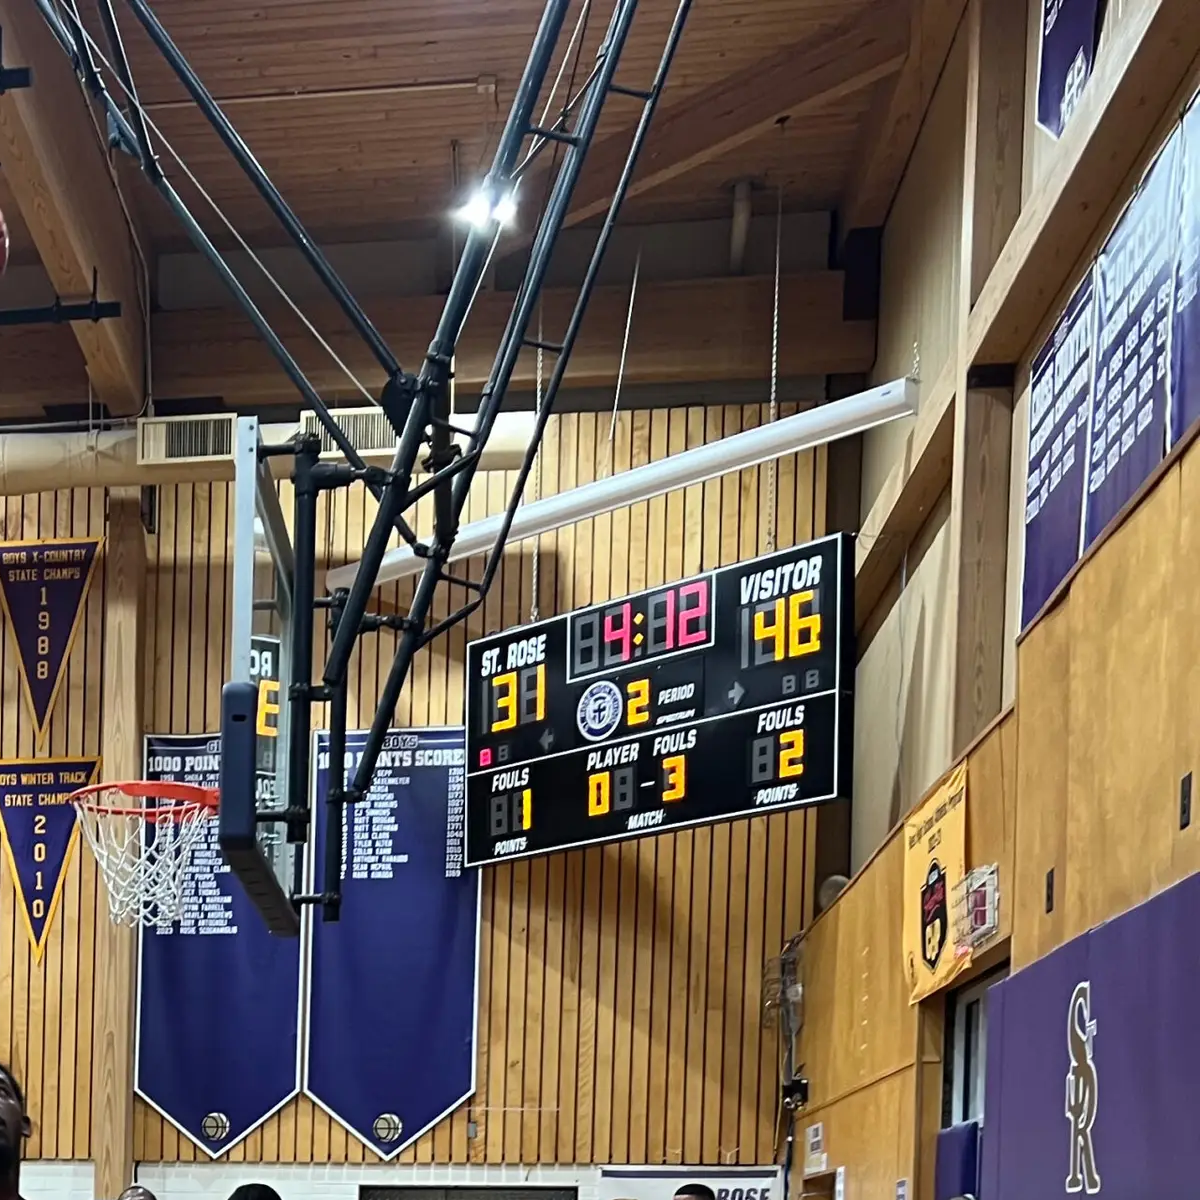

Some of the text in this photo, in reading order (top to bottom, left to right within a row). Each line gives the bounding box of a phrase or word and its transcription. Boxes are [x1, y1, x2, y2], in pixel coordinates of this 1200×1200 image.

[2, 548, 87, 564] BOYS X-COUNTRY
[8, 567, 81, 581] STATE CHAMPS
[740, 554, 823, 605] VISITOR
[37, 587, 49, 679] 1988
[604, 580, 708, 661] 4:12
[753, 590, 821, 662] 46
[481, 634, 547, 677] ST. ROSE
[491, 664, 546, 733] 31
[626, 679, 650, 726] 2
[658, 682, 695, 706] PERIOD
[756, 704, 805, 734] FOULS
[148, 755, 220, 772] 1000 POIN
[586, 729, 697, 771] PLAYER FOULS
[779, 729, 805, 779] 2
[21, 772, 54, 785] WINTER
[59, 771, 87, 784] TRACK
[491, 767, 530, 792] FOULS
[661, 754, 686, 802] 3
[756, 783, 799, 805] POINTS
[4, 793, 70, 807] STATE CHAMP
[628, 811, 663, 830] MATCH
[494, 837, 527, 856] POINTS
[33, 815, 46, 918] 2010
